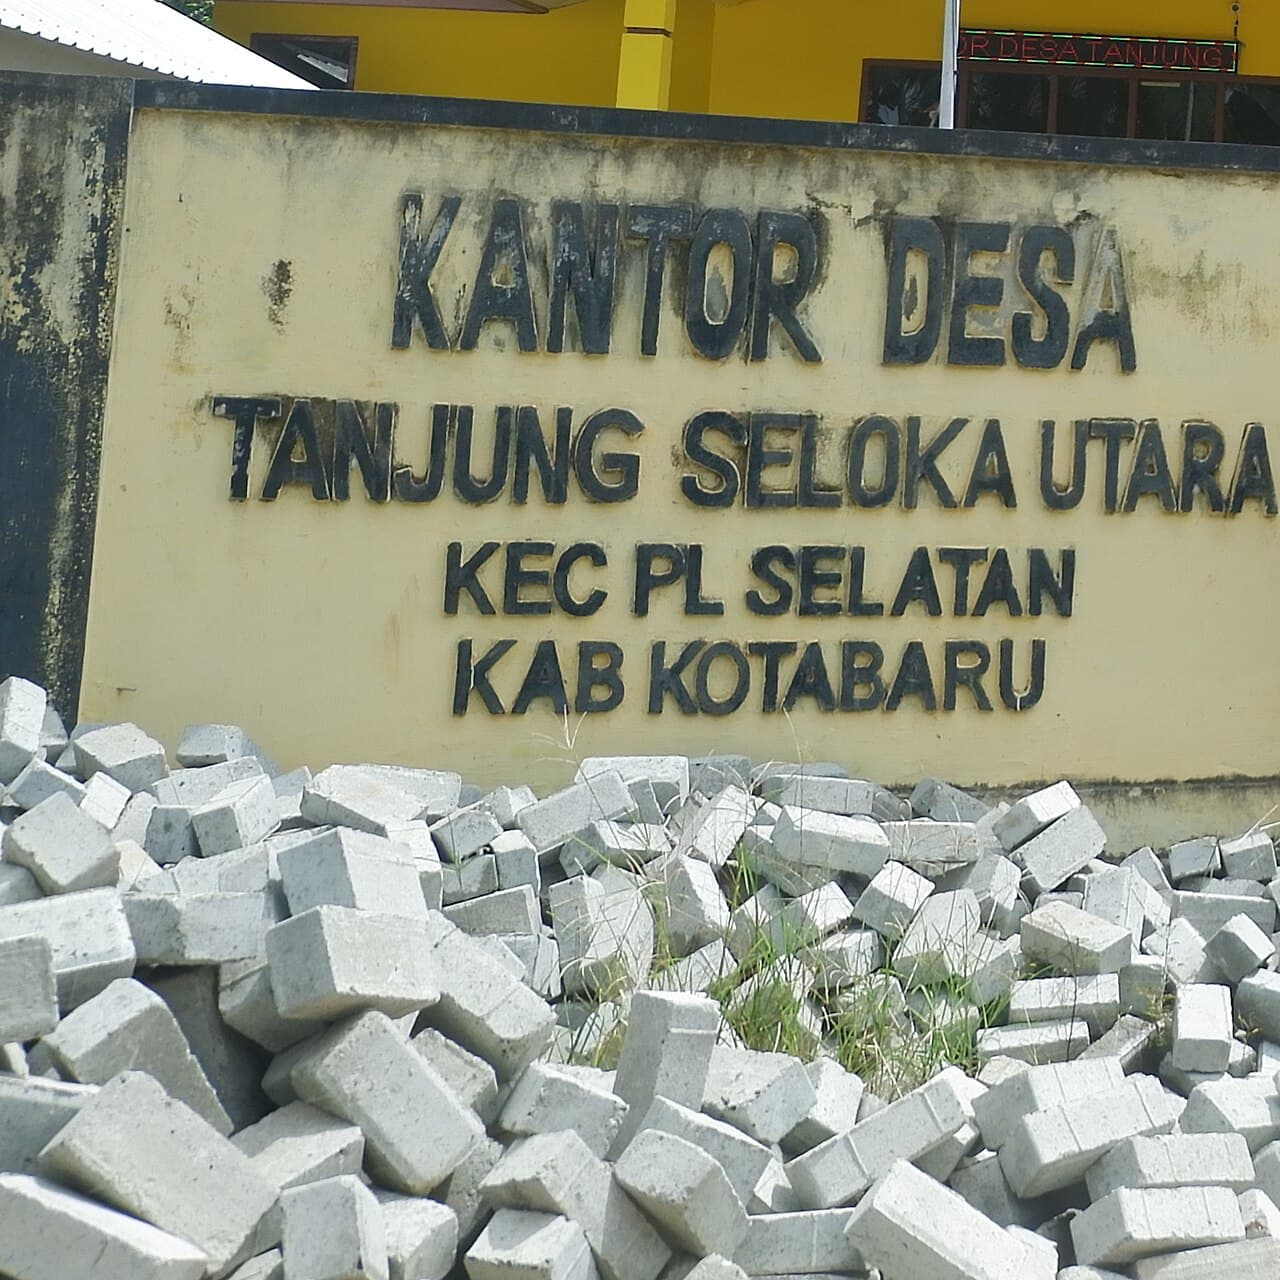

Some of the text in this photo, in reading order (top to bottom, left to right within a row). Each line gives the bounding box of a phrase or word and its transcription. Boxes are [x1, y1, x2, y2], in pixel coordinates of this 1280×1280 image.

[1000, 38, 1078, 61] DESA
[1087, 42, 1223, 67] TANJUNG
[391, 193, 1137, 373] KANTOR DESA
[212, 395, 1279, 516] TANJUNG SELOKA UTARA
[443, 540, 1076, 617] KEC PL SELATAN
[452, 637, 1047, 716] KAB KOTABARU
